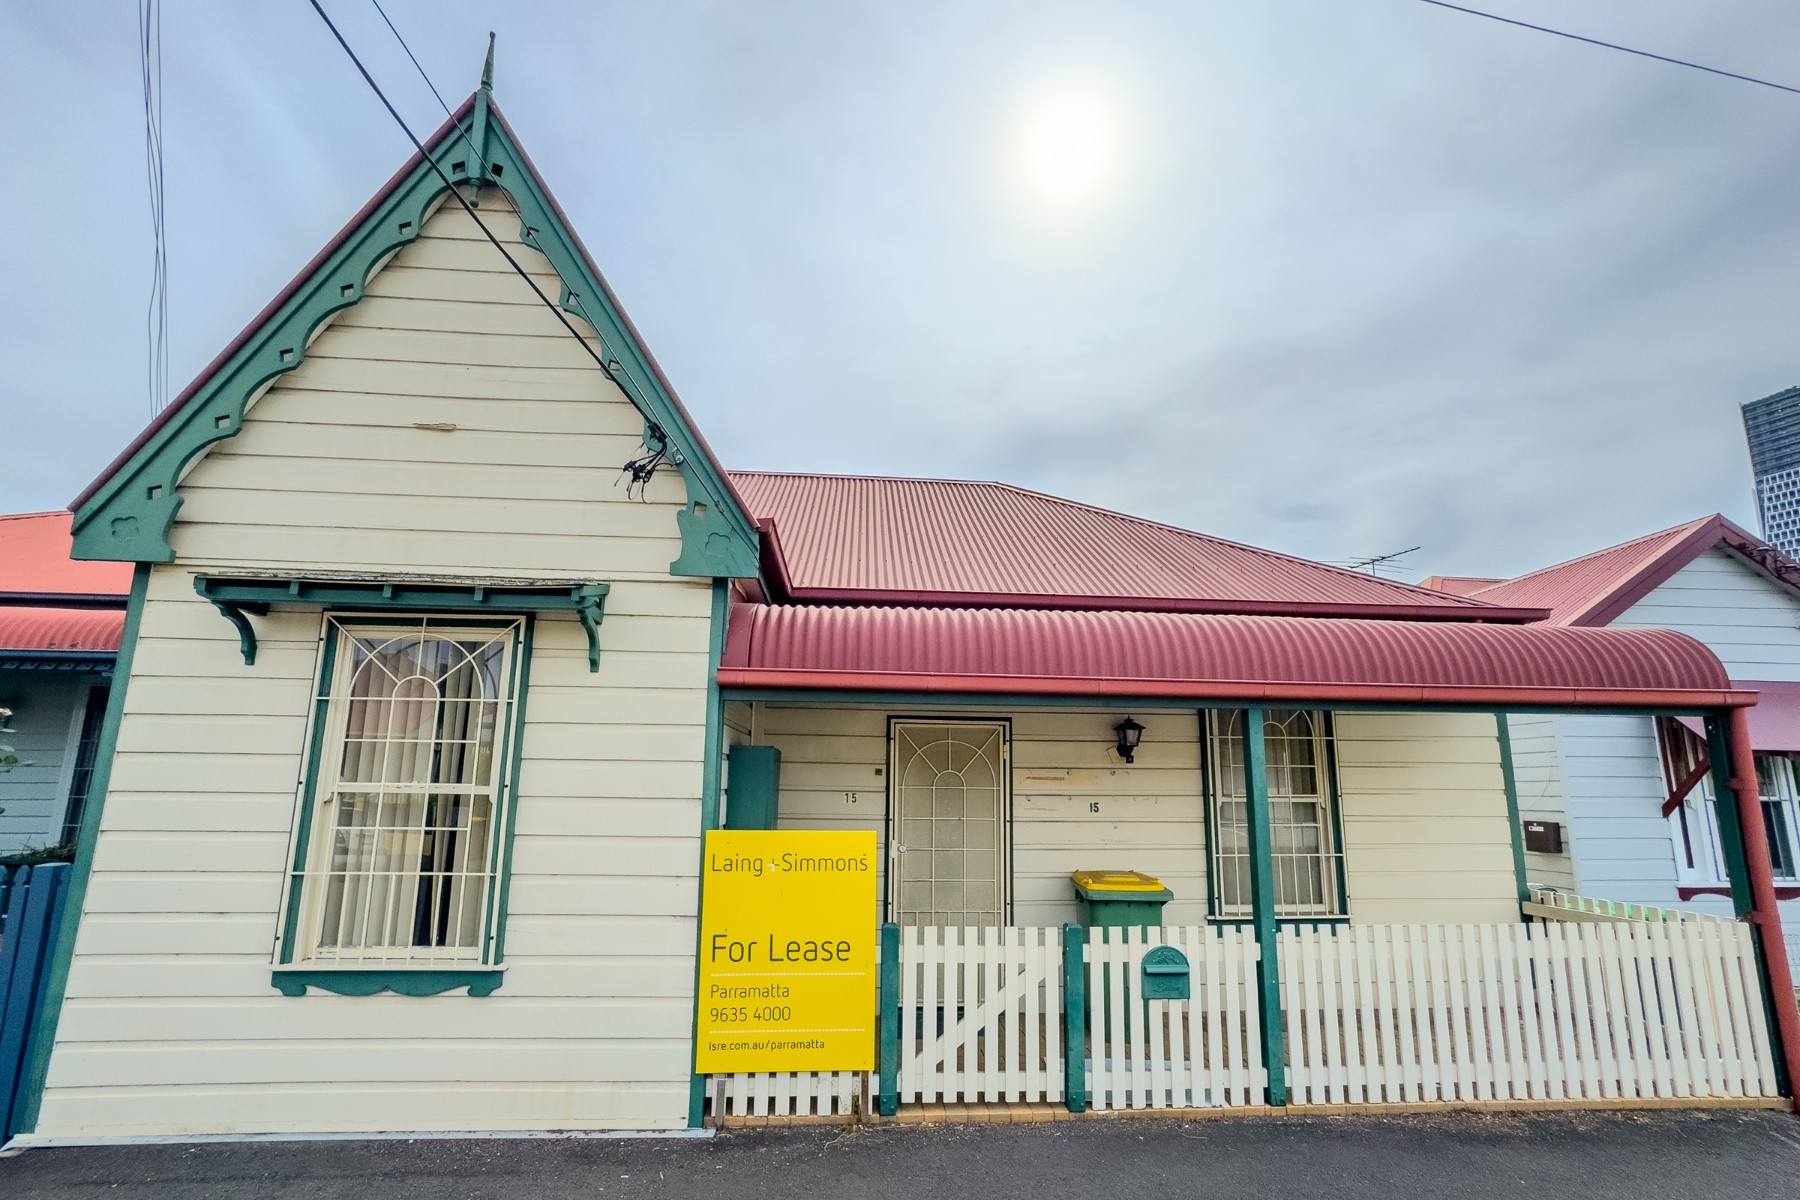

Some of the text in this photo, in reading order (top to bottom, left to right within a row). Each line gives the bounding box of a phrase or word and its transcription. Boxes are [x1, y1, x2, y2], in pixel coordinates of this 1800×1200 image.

[844, 792, 857, 803] 15
[1089, 802, 1100, 813] 15
[711, 934, 851, 963] For Lease
[710, 984, 790, 998] Parramatta
[710, 1006, 791, 1022] 9635 4000
[708, 1039, 825, 1052] lsre.com.au/parramatta
